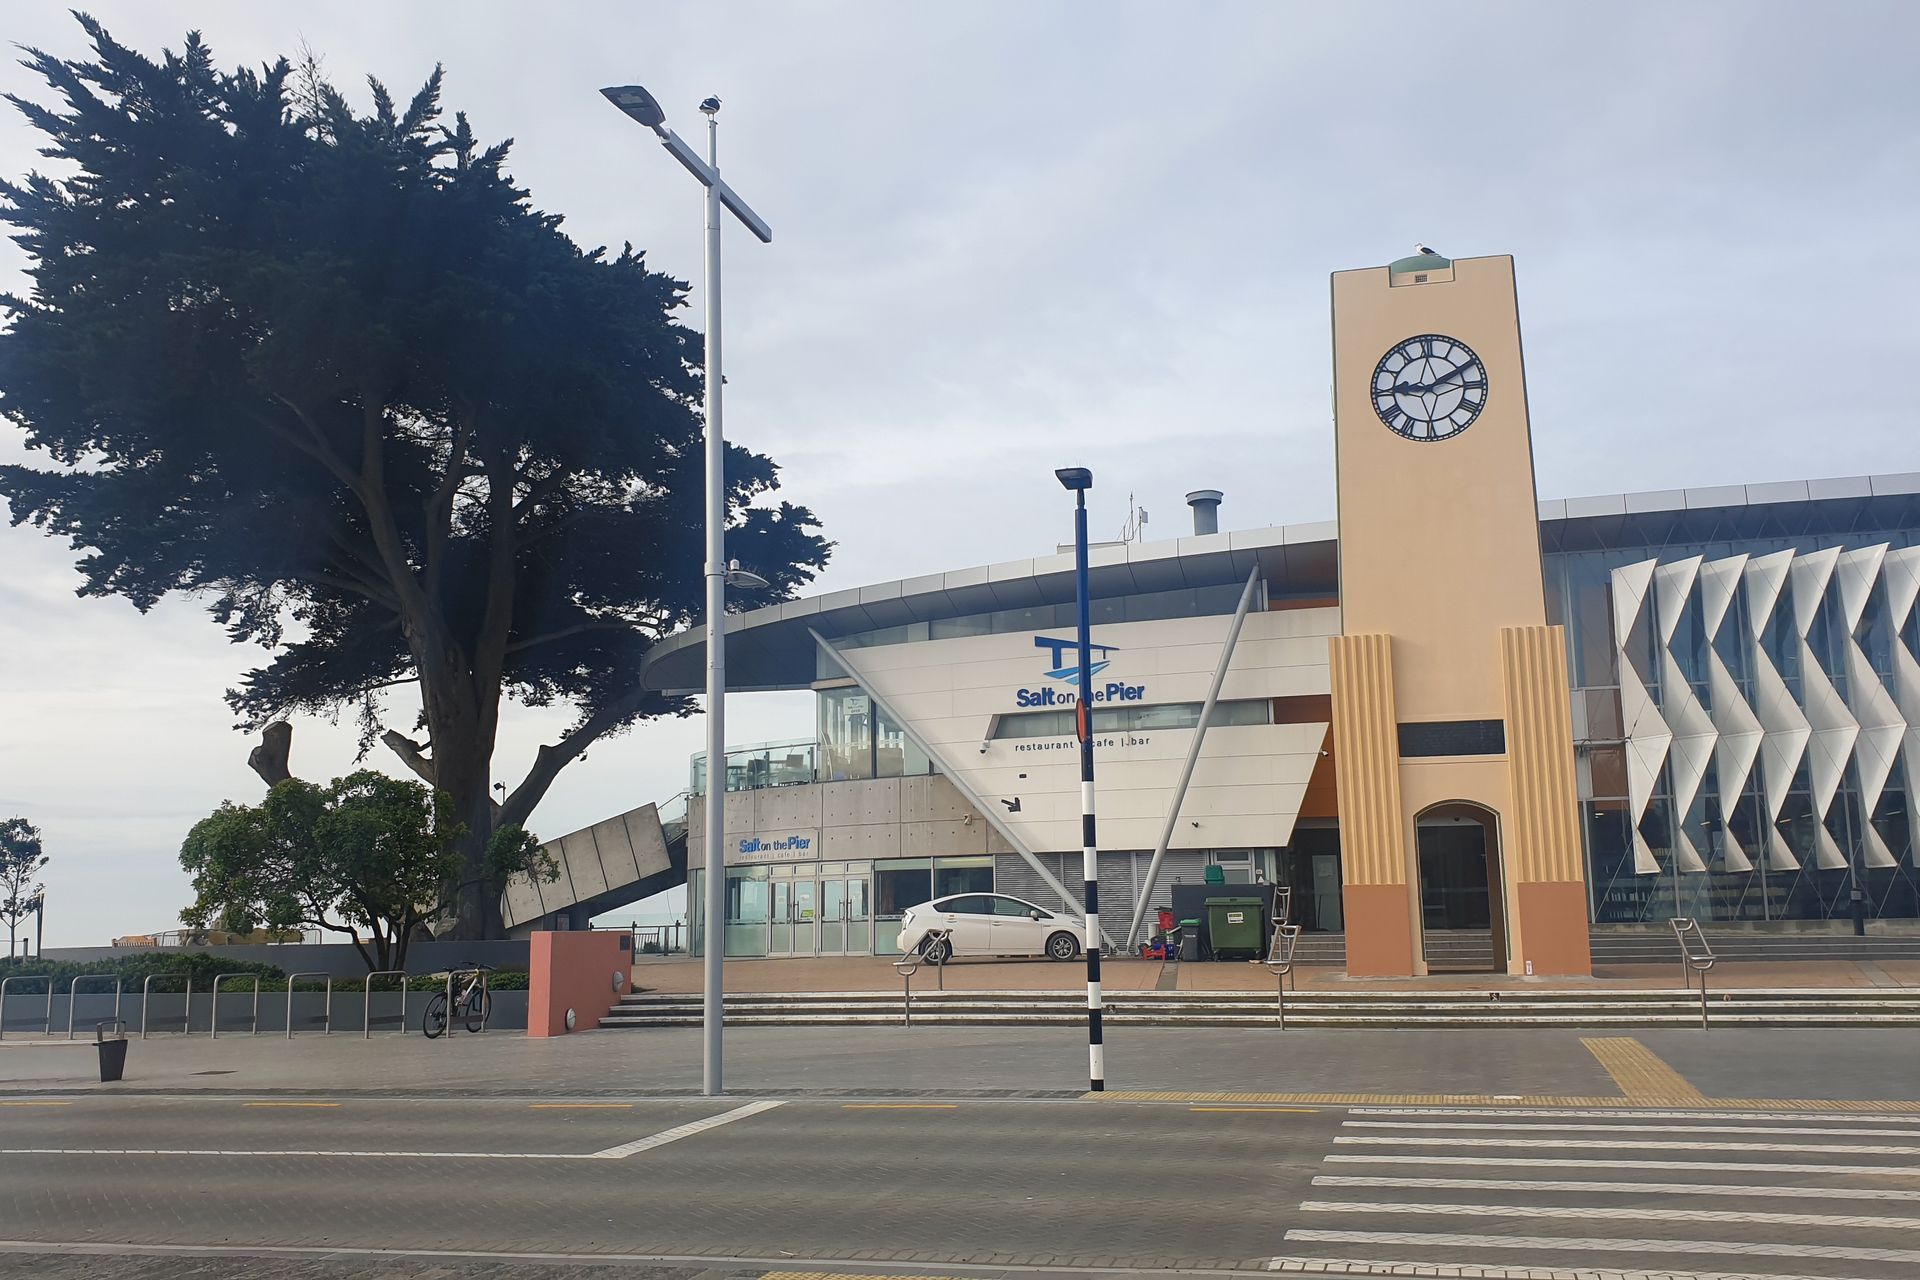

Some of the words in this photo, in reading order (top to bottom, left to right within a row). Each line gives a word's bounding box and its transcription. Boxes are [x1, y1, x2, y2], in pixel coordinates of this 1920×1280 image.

[1016, 687, 1055, 707] Salt
[1057, 693, 1075, 704] on
[1106, 682, 1145, 701] Pier
[1015, 741, 1074, 752] restaurant
[1131, 737, 1150, 746] bar
[739, 837, 761, 853] Salt
[761, 842, 771, 851] on
[773, 840, 787, 851] the
[788, 835, 811, 850] Pier
